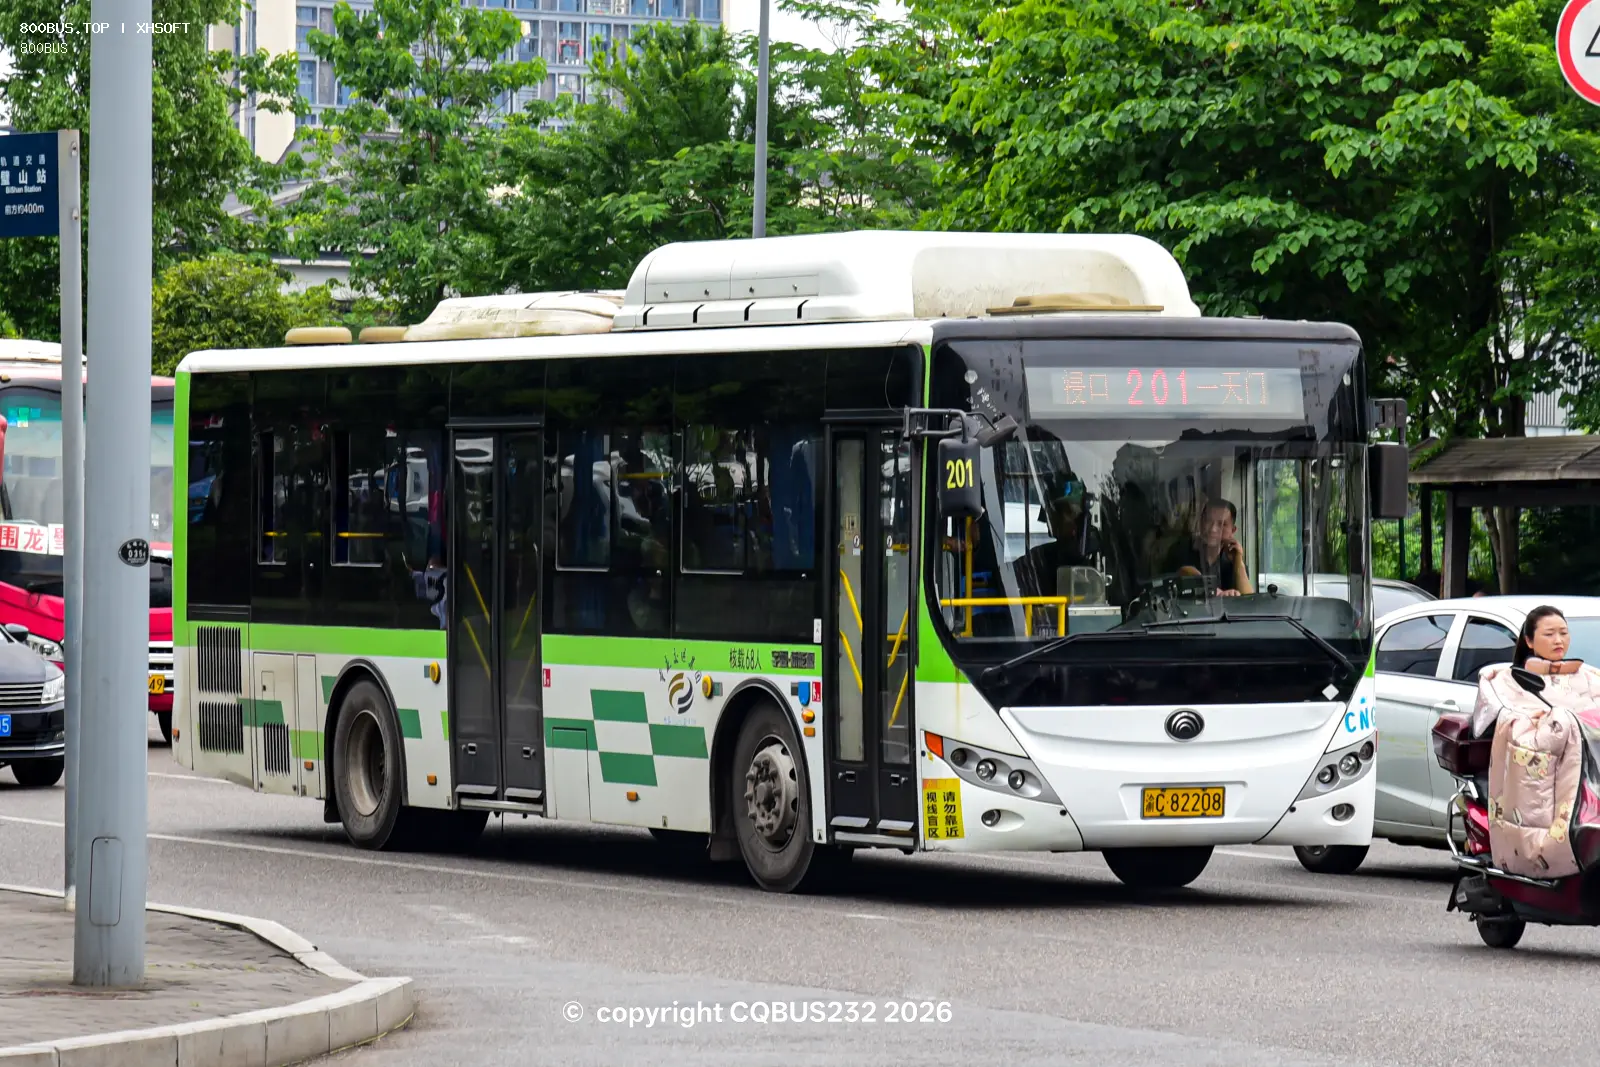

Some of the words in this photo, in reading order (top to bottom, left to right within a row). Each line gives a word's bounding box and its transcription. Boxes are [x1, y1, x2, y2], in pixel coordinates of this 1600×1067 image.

[1126, 368, 1188, 406] 201
[946, 458, 973, 490] 201
[729, 647, 762, 670] 核载68人
[926, 791, 939, 838] 视线盲区
[943, 791, 959, 838] 请勿靠近
